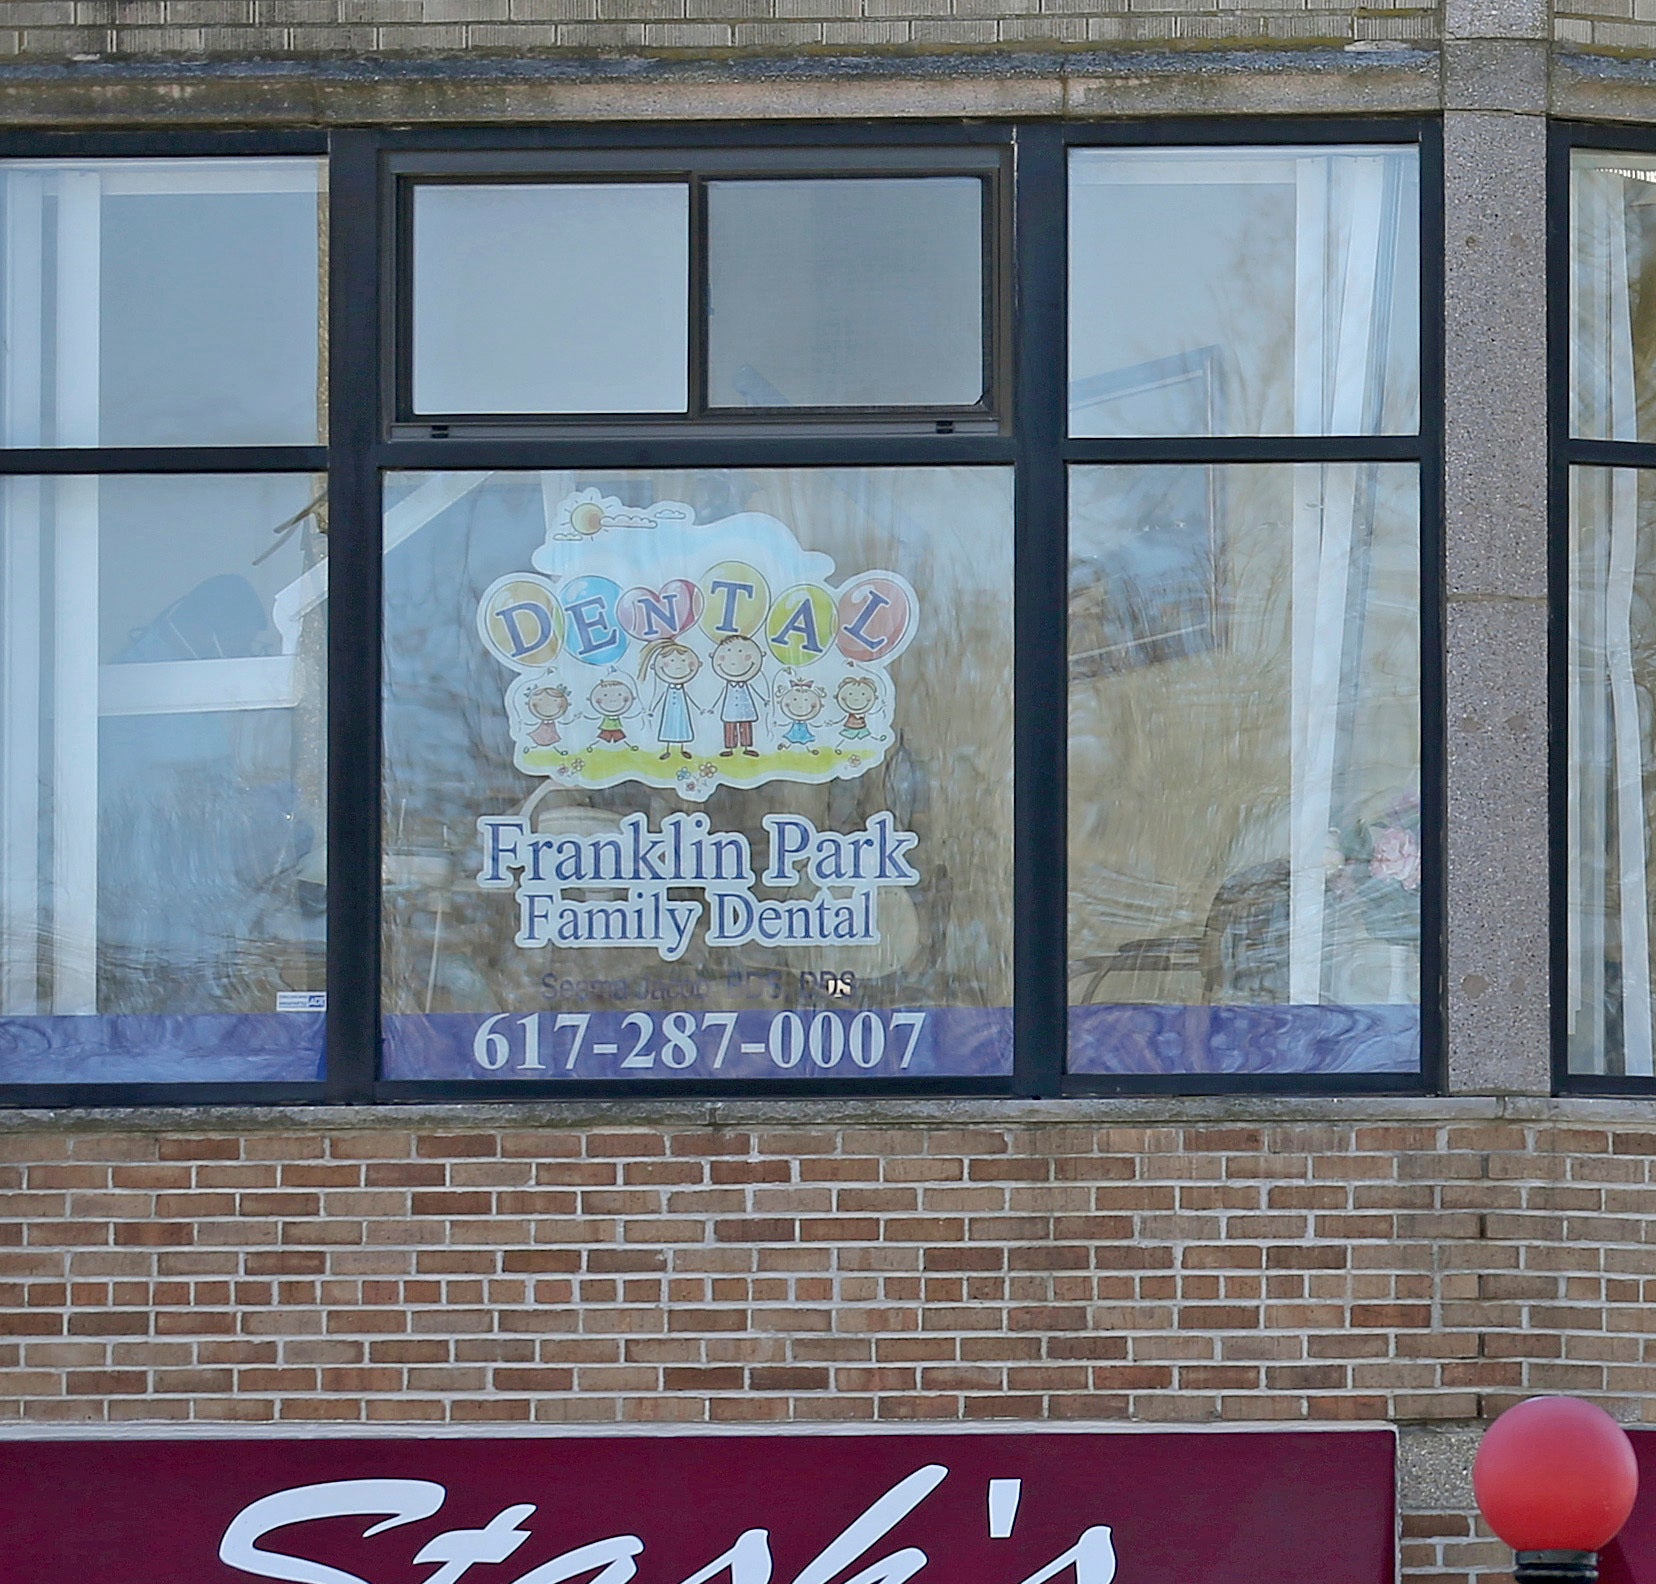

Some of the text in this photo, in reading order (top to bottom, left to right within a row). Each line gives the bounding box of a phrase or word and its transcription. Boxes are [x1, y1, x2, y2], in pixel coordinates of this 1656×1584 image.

[495, 579, 891, 658] DENTAL
[482, 816, 917, 882] Franklin Park
[523, 891, 874, 953] Family Dental
[473, 1011, 926, 1070] 617-287-0007
